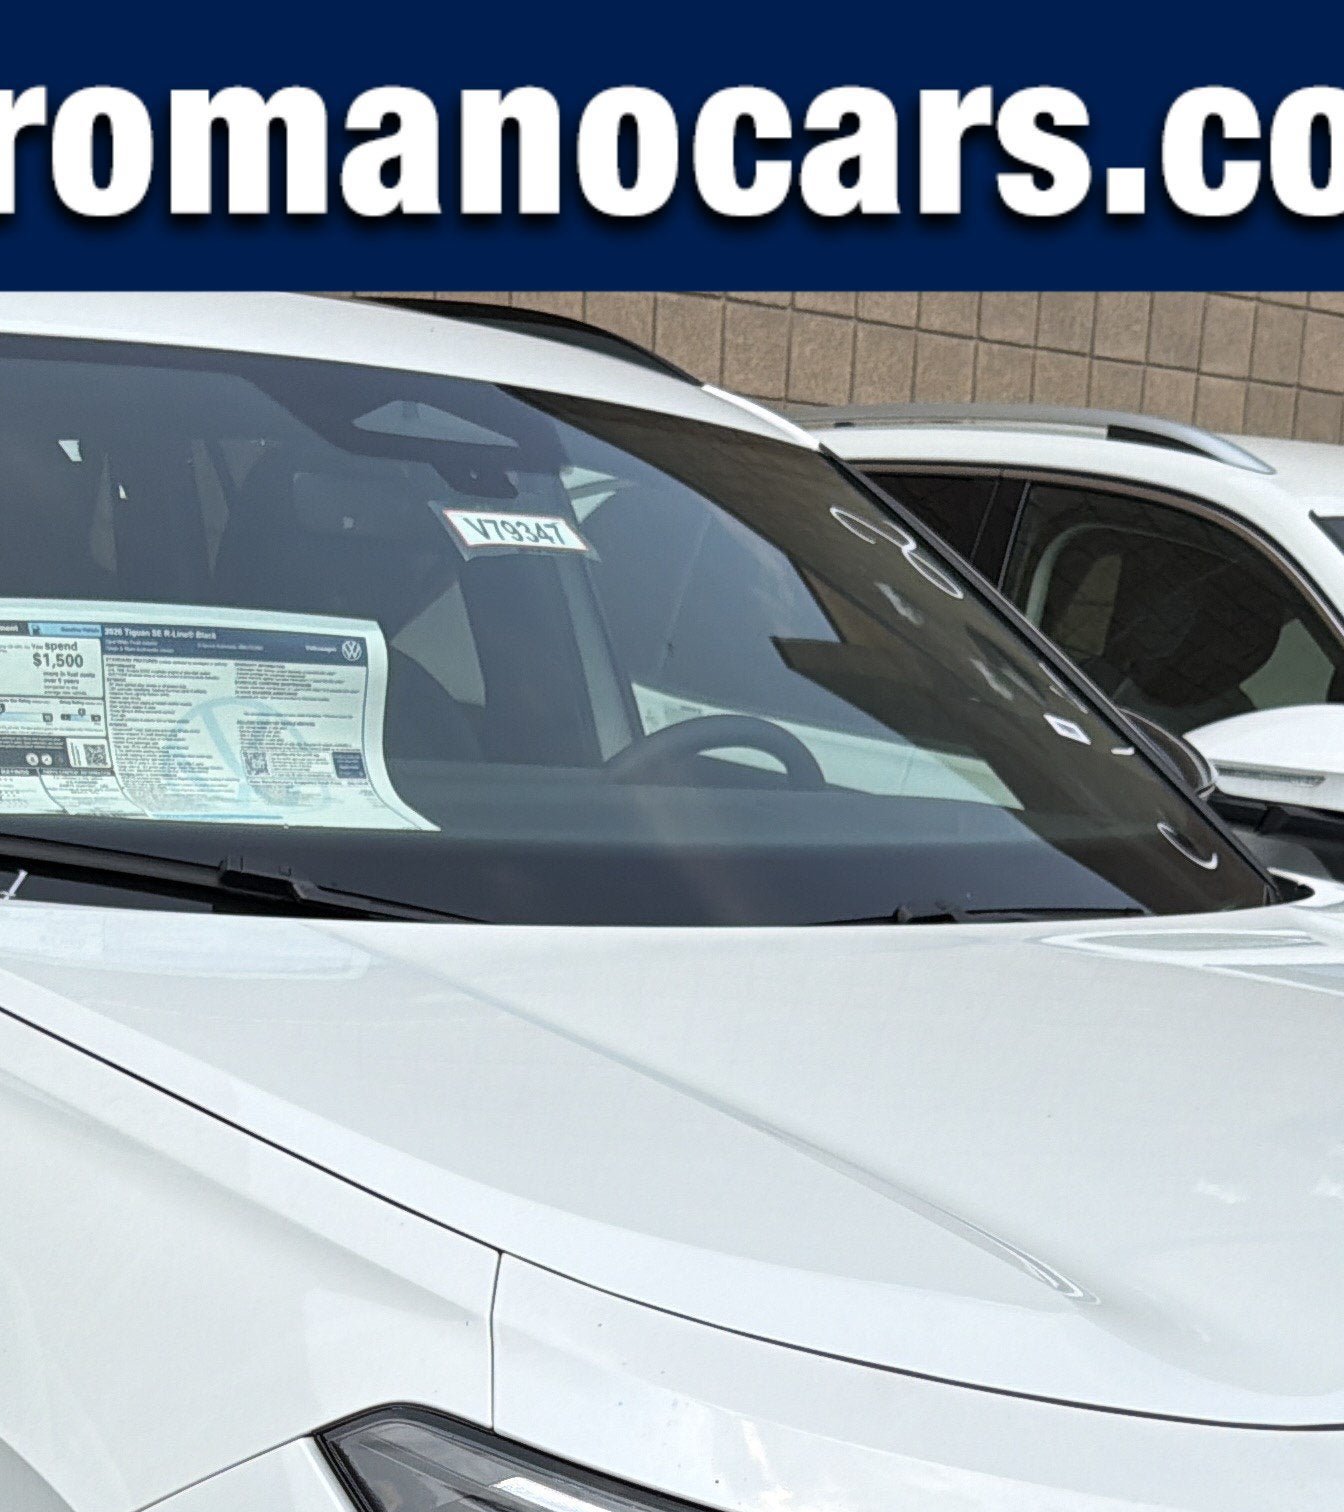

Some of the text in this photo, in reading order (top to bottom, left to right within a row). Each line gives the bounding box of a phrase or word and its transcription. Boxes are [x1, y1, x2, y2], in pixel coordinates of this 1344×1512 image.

[462, 517, 566, 546] V79347
[124, 627, 151, 638] Tiguan
[44, 641, 79, 653] spend
[32, 652, 84, 669] $1,500
